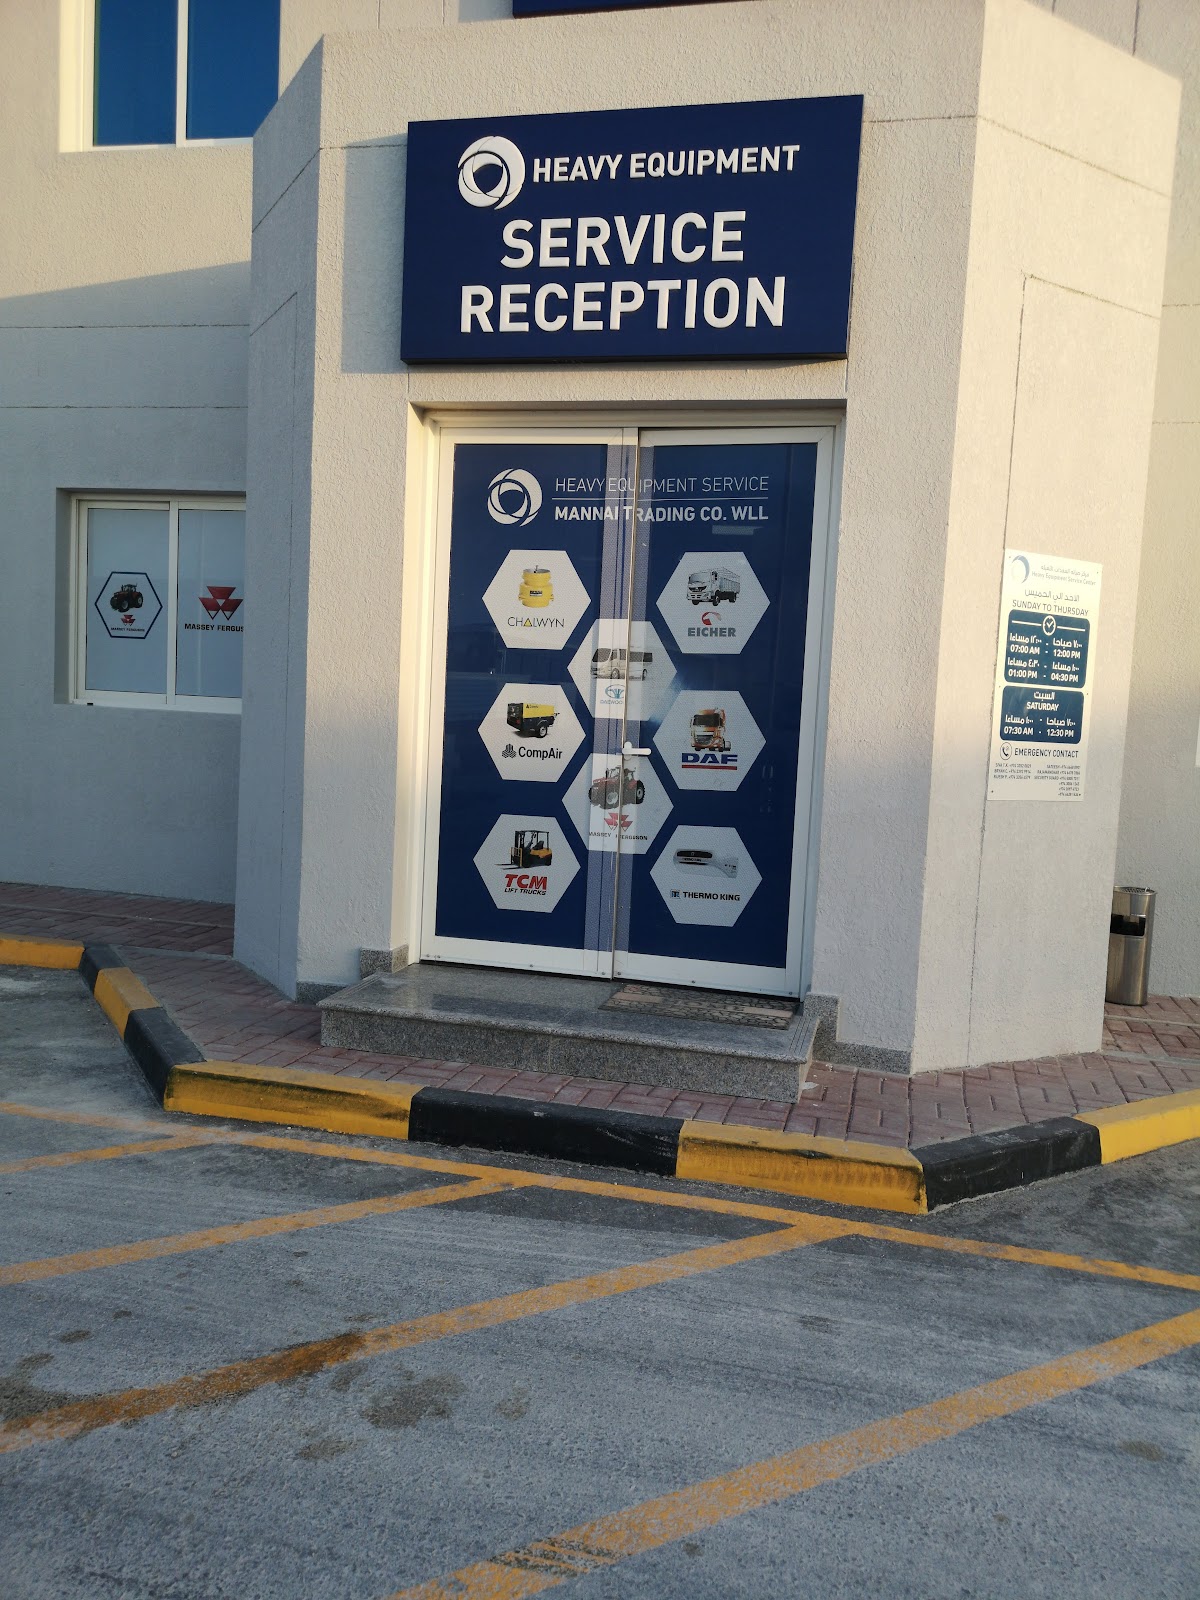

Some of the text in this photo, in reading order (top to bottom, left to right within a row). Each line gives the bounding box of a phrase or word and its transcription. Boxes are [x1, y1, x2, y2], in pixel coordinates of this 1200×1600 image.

[533, 144, 800, 184] HEAVY EQUIPMENT
[500, 210, 746, 269] SERVICE
[460, 276, 786, 333] RECEPTION
[555, 476, 769, 493] HEAVY EQUIPMENT SERVICE
[555, 505, 769, 522] MANNAI TRADING CO. WLL
[1012, 599, 1089, 616] SUNDAY TO THURSDAY
[184, 623, 215, 631] MASSEY
[507, 616, 565, 629] CHALWYN
[687, 627, 737, 638] EICHER
[1010, 644, 1081, 659] 07:00 AM 12:00 PM
[1008, 668, 1079, 682] 01:00 PM 04:30 PM
[1027, 701, 1059, 711] SATURDAY
[1004, 725, 1074, 738] 07:30 AM 12:30 PM
[518, 746, 563, 760] CompAir
[682, 753, 738, 764] DAF
[1014, 747, 1079, 758] EMERGENCY CONTACT
[505, 874, 548, 890] TCM
[683, 891, 740, 901] THERMO KING
